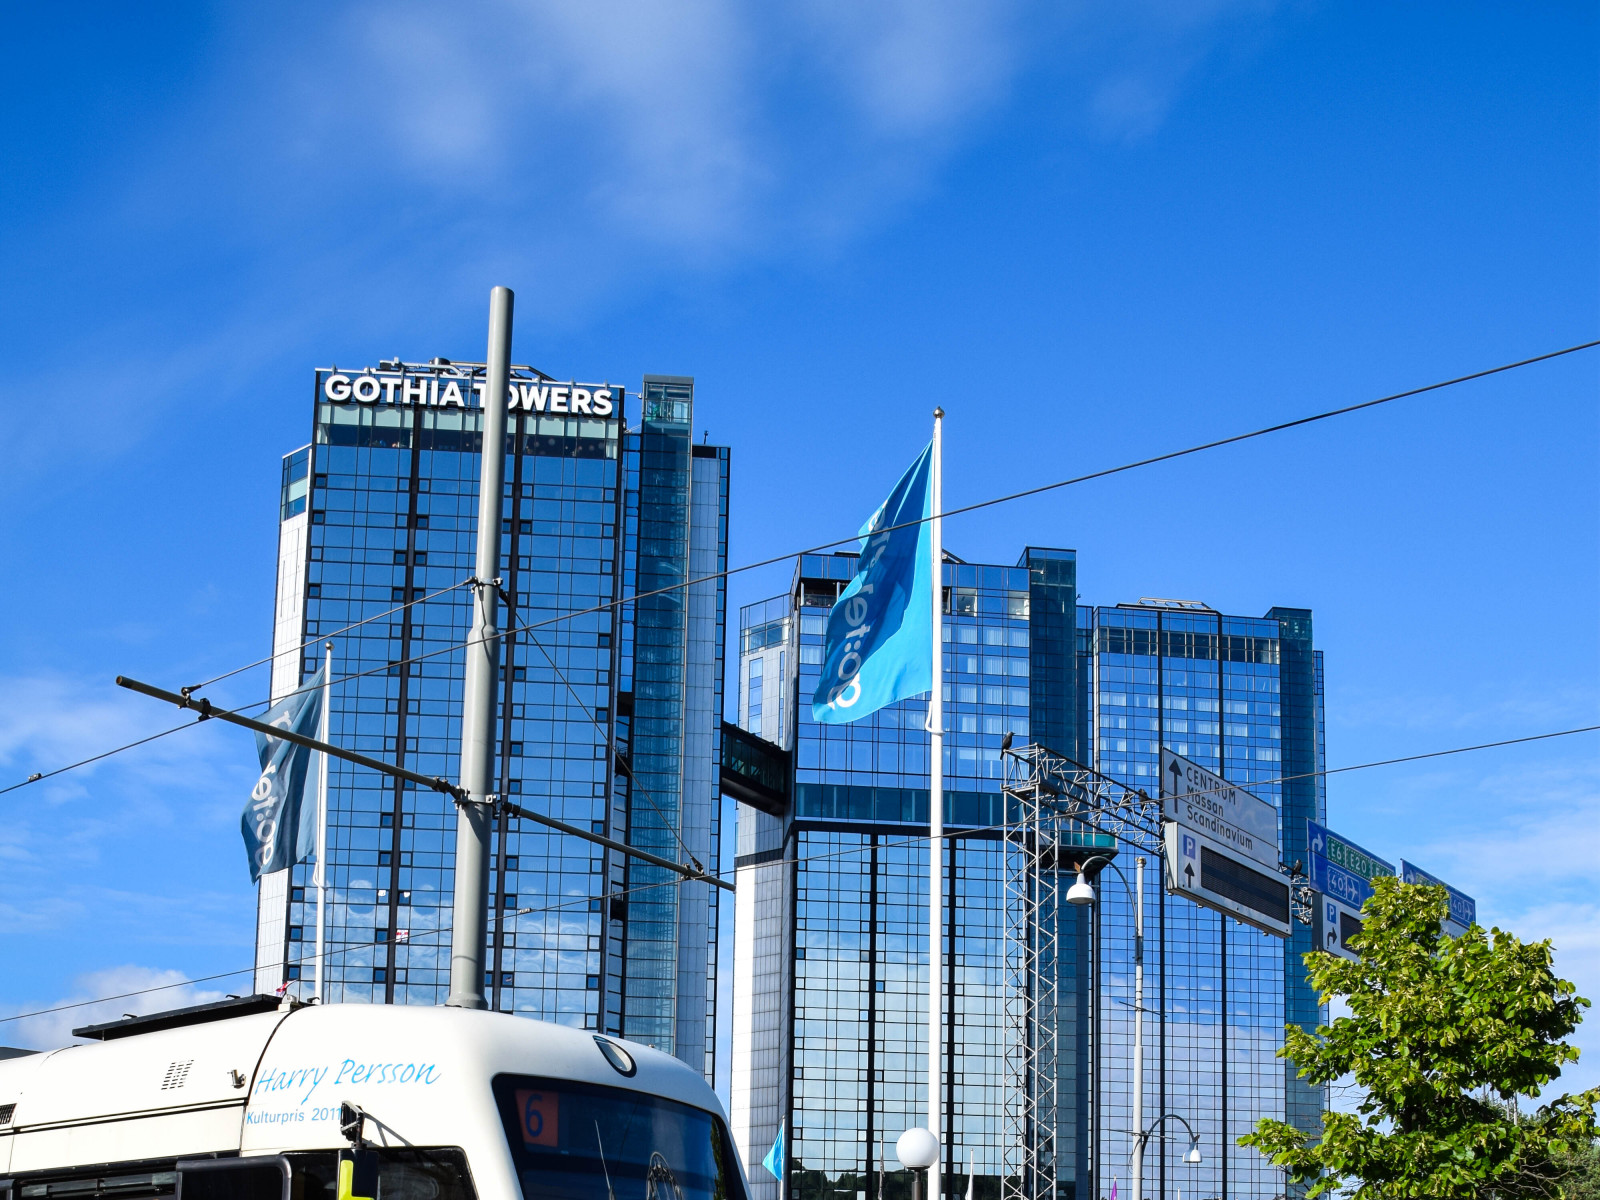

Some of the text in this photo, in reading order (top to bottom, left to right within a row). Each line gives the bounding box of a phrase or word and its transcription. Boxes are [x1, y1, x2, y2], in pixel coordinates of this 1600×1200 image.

[325, 375, 465, 407] GOTHIA
[1186, 766, 1236, 806] CENTRUM
[1186, 784, 1224, 818] Mässan
[1186, 804, 1253, 851] Scandinavium
[1186, 835, 1194, 856] P
[1331, 844, 1342, 861] E6
[1350, 852, 1367, 874] E20
[1331, 877, 1344, 892] 40
[1329, 907, 1335, 921] P
[254, 1058, 442, 1106] Harry Persson
[246, 1109, 305, 1126] Kulturpris
[525, 1093, 543, 1138] 6
